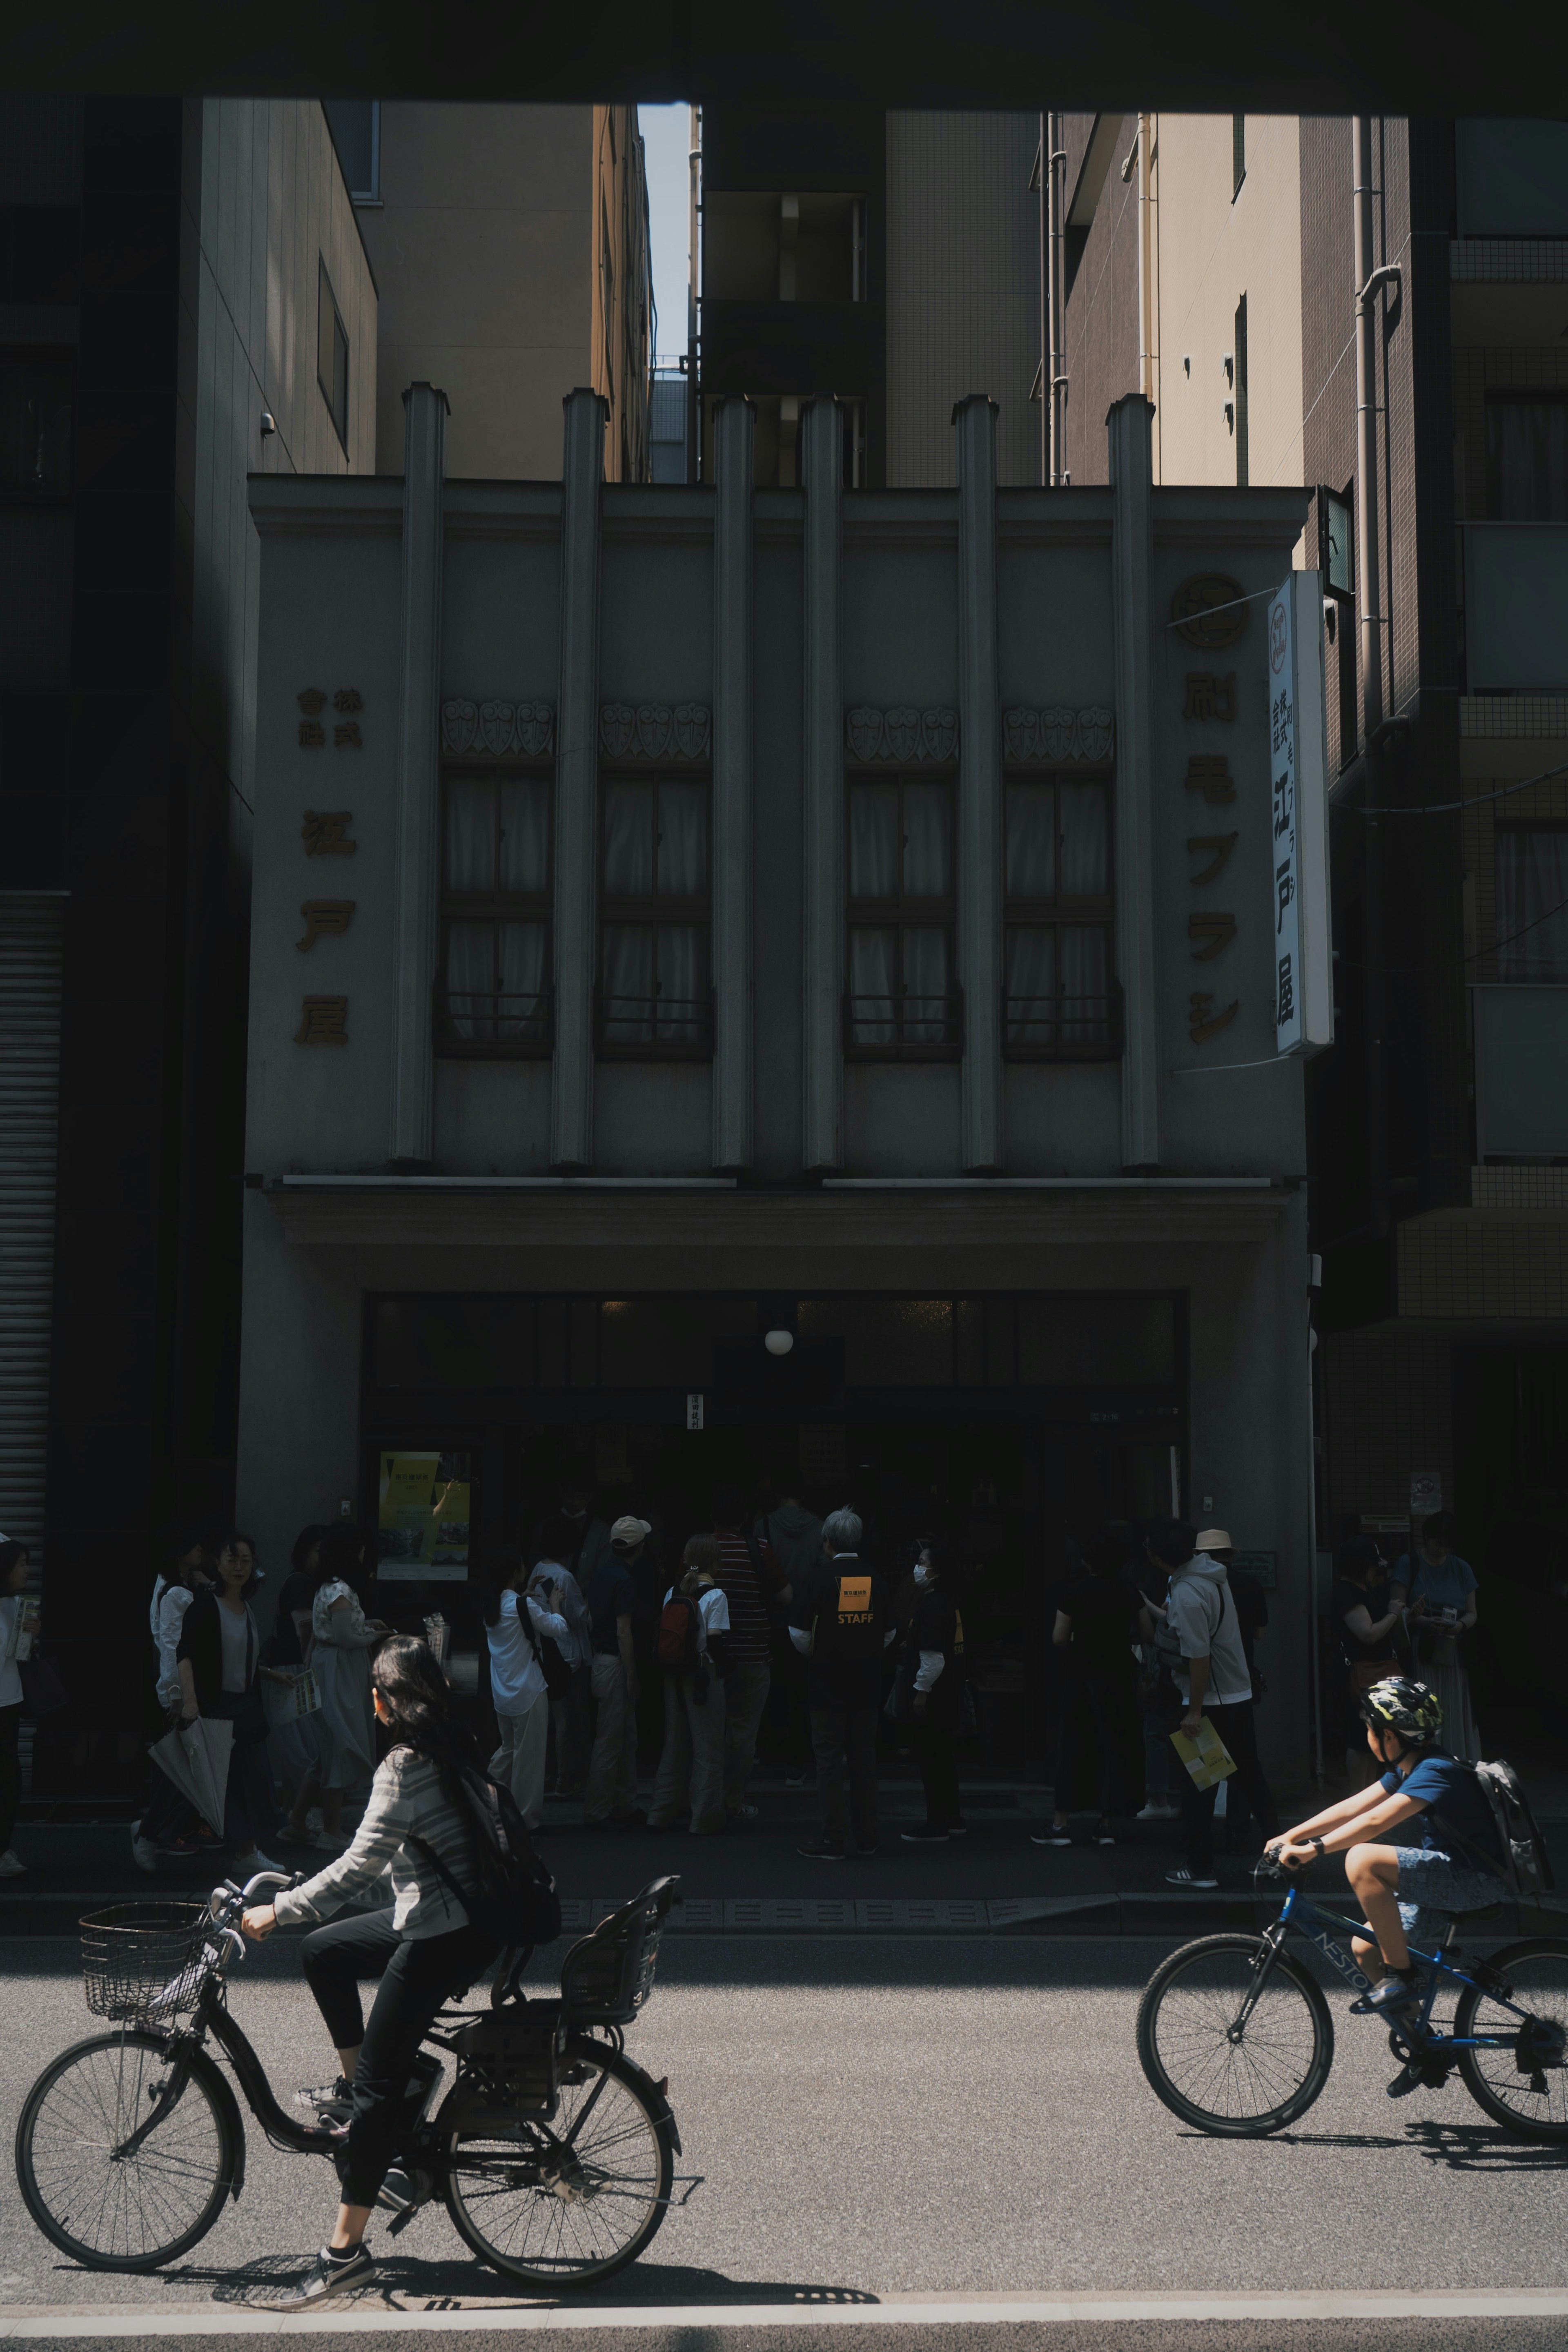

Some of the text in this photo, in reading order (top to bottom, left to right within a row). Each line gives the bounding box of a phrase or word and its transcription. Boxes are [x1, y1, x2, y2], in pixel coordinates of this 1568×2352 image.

[1183, 670, 1238, 1044] 刷毛ブラシ
[1274, 770, 1295, 1027] 江戸屋
[1287, 703, 1295, 902] 刷毛ブラシ
[293, 810, 356, 1045] 江戸屋
[837, 1613, 874, 1624] STAFF
[1314, 1931, 1368, 1989] NESTO
